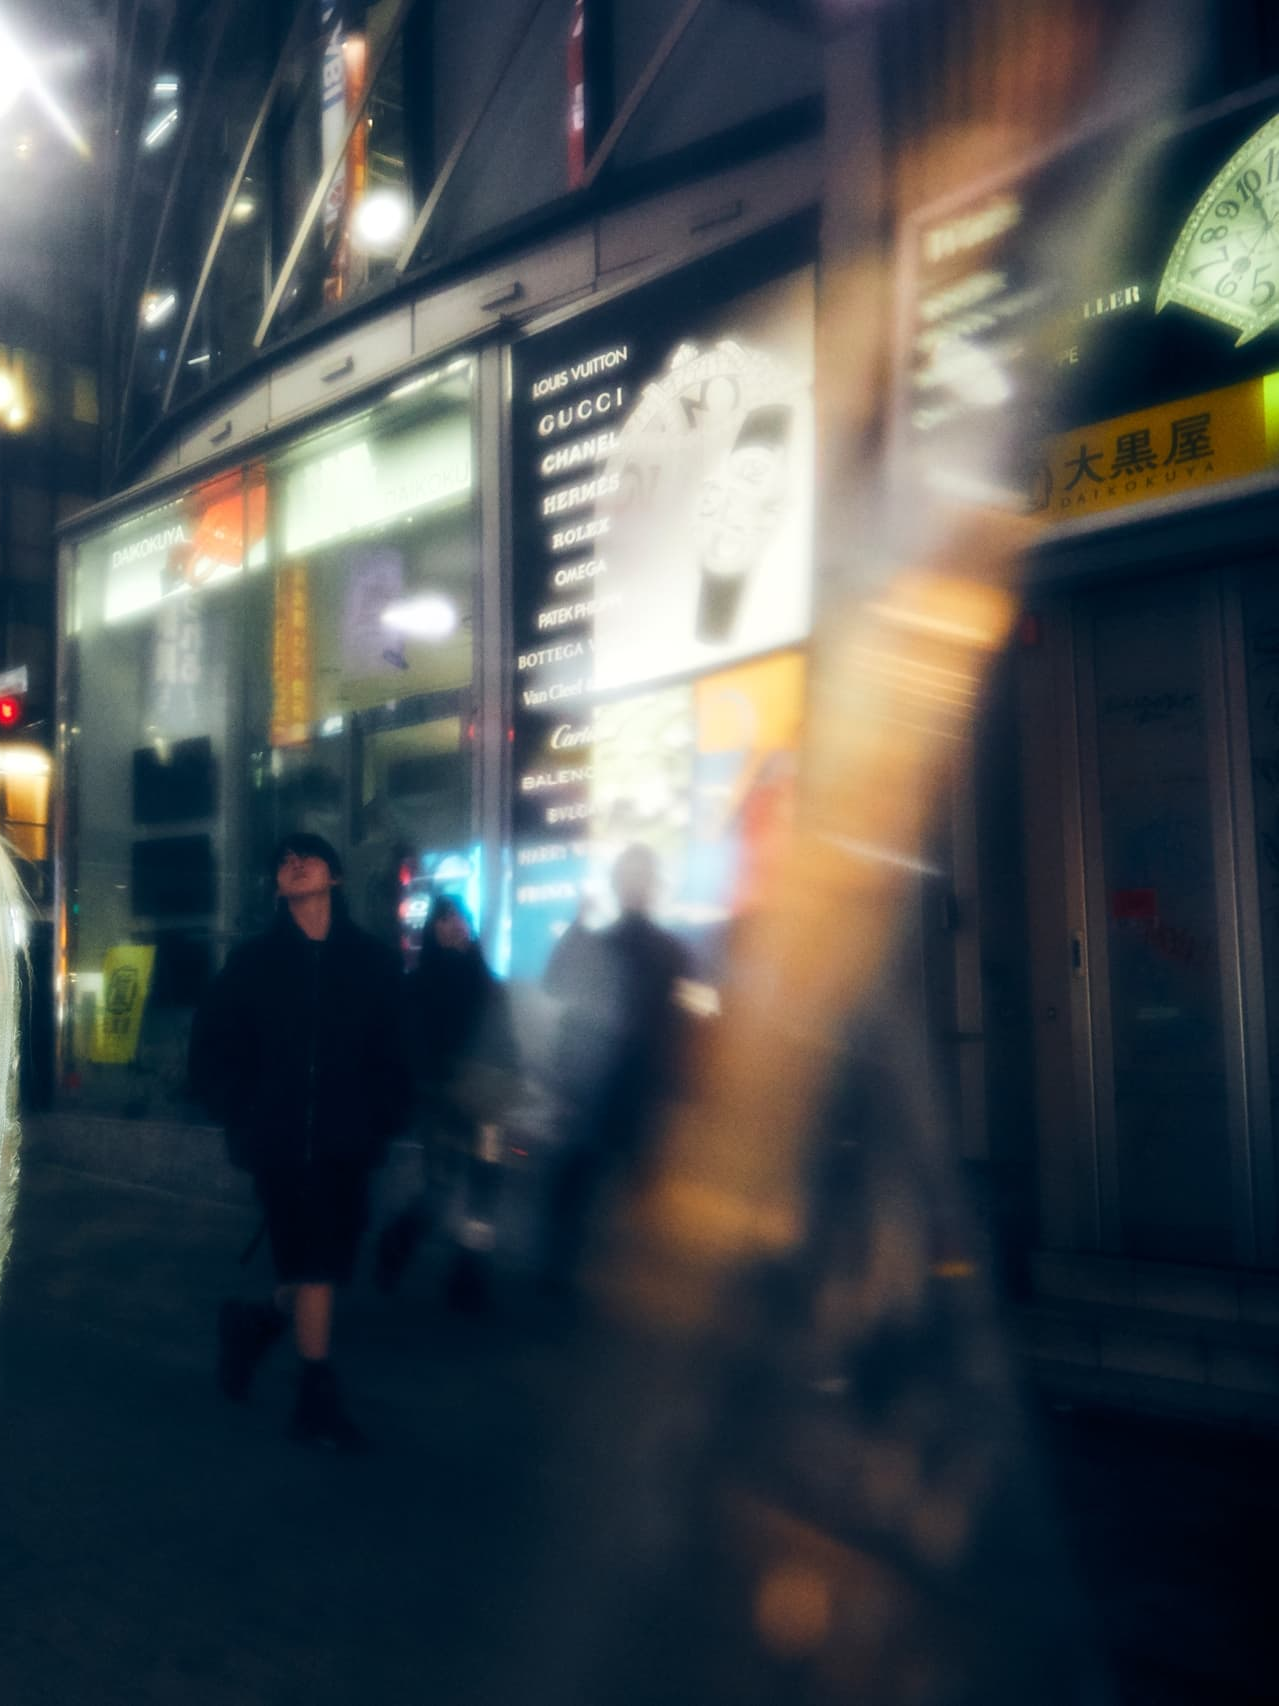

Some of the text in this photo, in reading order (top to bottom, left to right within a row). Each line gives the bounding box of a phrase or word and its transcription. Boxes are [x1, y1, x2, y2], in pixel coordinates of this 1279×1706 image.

[1083, 285, 1140, 319] LLER
[532, 345, 628, 399] LOUIS VUITTON
[538, 386, 623, 436] GUCCI
[540, 431, 619, 475] CHANEL
[1064, 412, 1214, 491] 大黒屋
[1060, 461, 1215, 508] DAIKOKUYA
[112, 524, 186, 569] DAIKOKUYA
[551, 517, 611, 550] ROLEX
[553, 558, 608, 586] OMEGA
[537, 605, 574, 630] PATEK
[517, 641, 584, 670] BOTTEGA
[522, 688, 548, 706] Van
